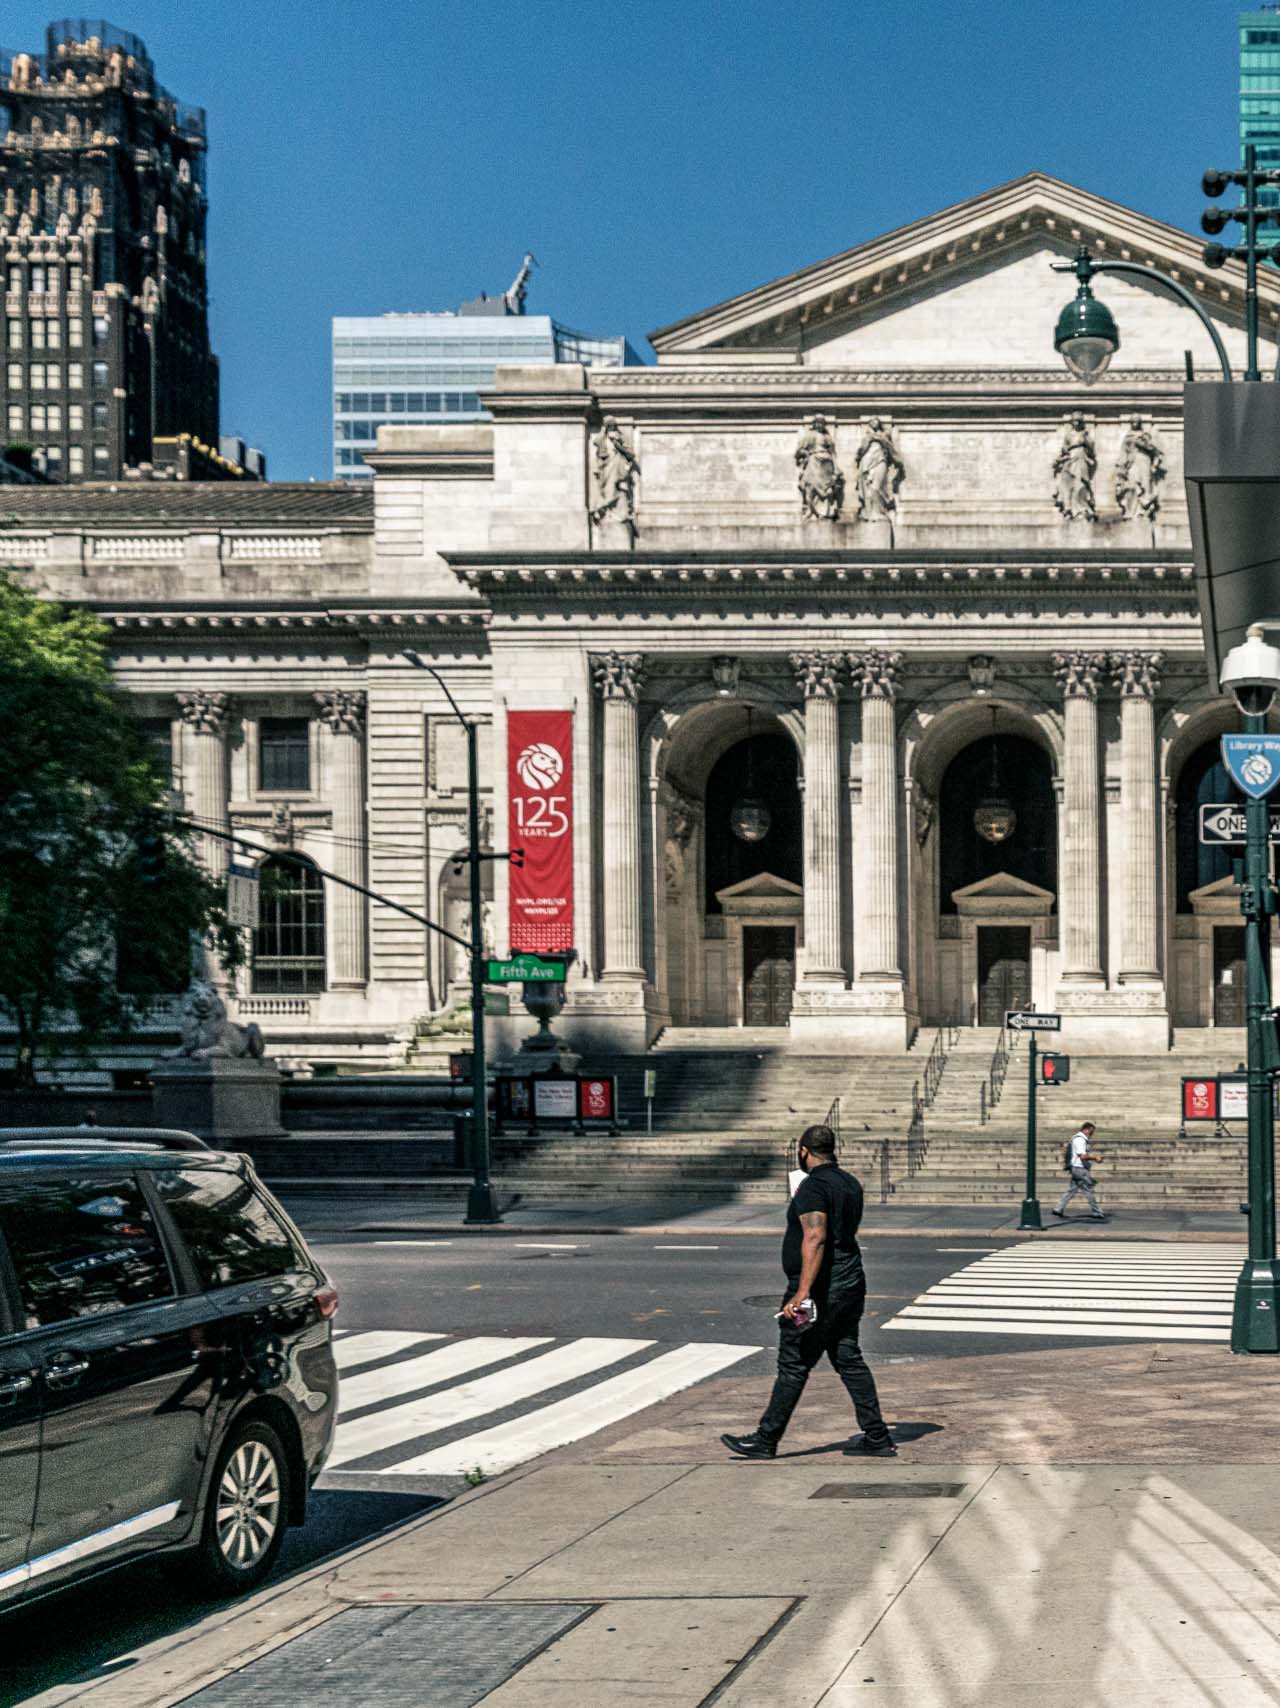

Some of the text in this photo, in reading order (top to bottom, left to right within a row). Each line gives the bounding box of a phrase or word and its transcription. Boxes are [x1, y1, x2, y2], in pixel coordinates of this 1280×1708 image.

[1230, 740, 1263, 752] Library
[512, 796, 569, 837] 125
[1216, 817, 1247, 831] ONE
[519, 828, 548, 837] YEARS
[500, 965, 554, 977] Fifth Ave
